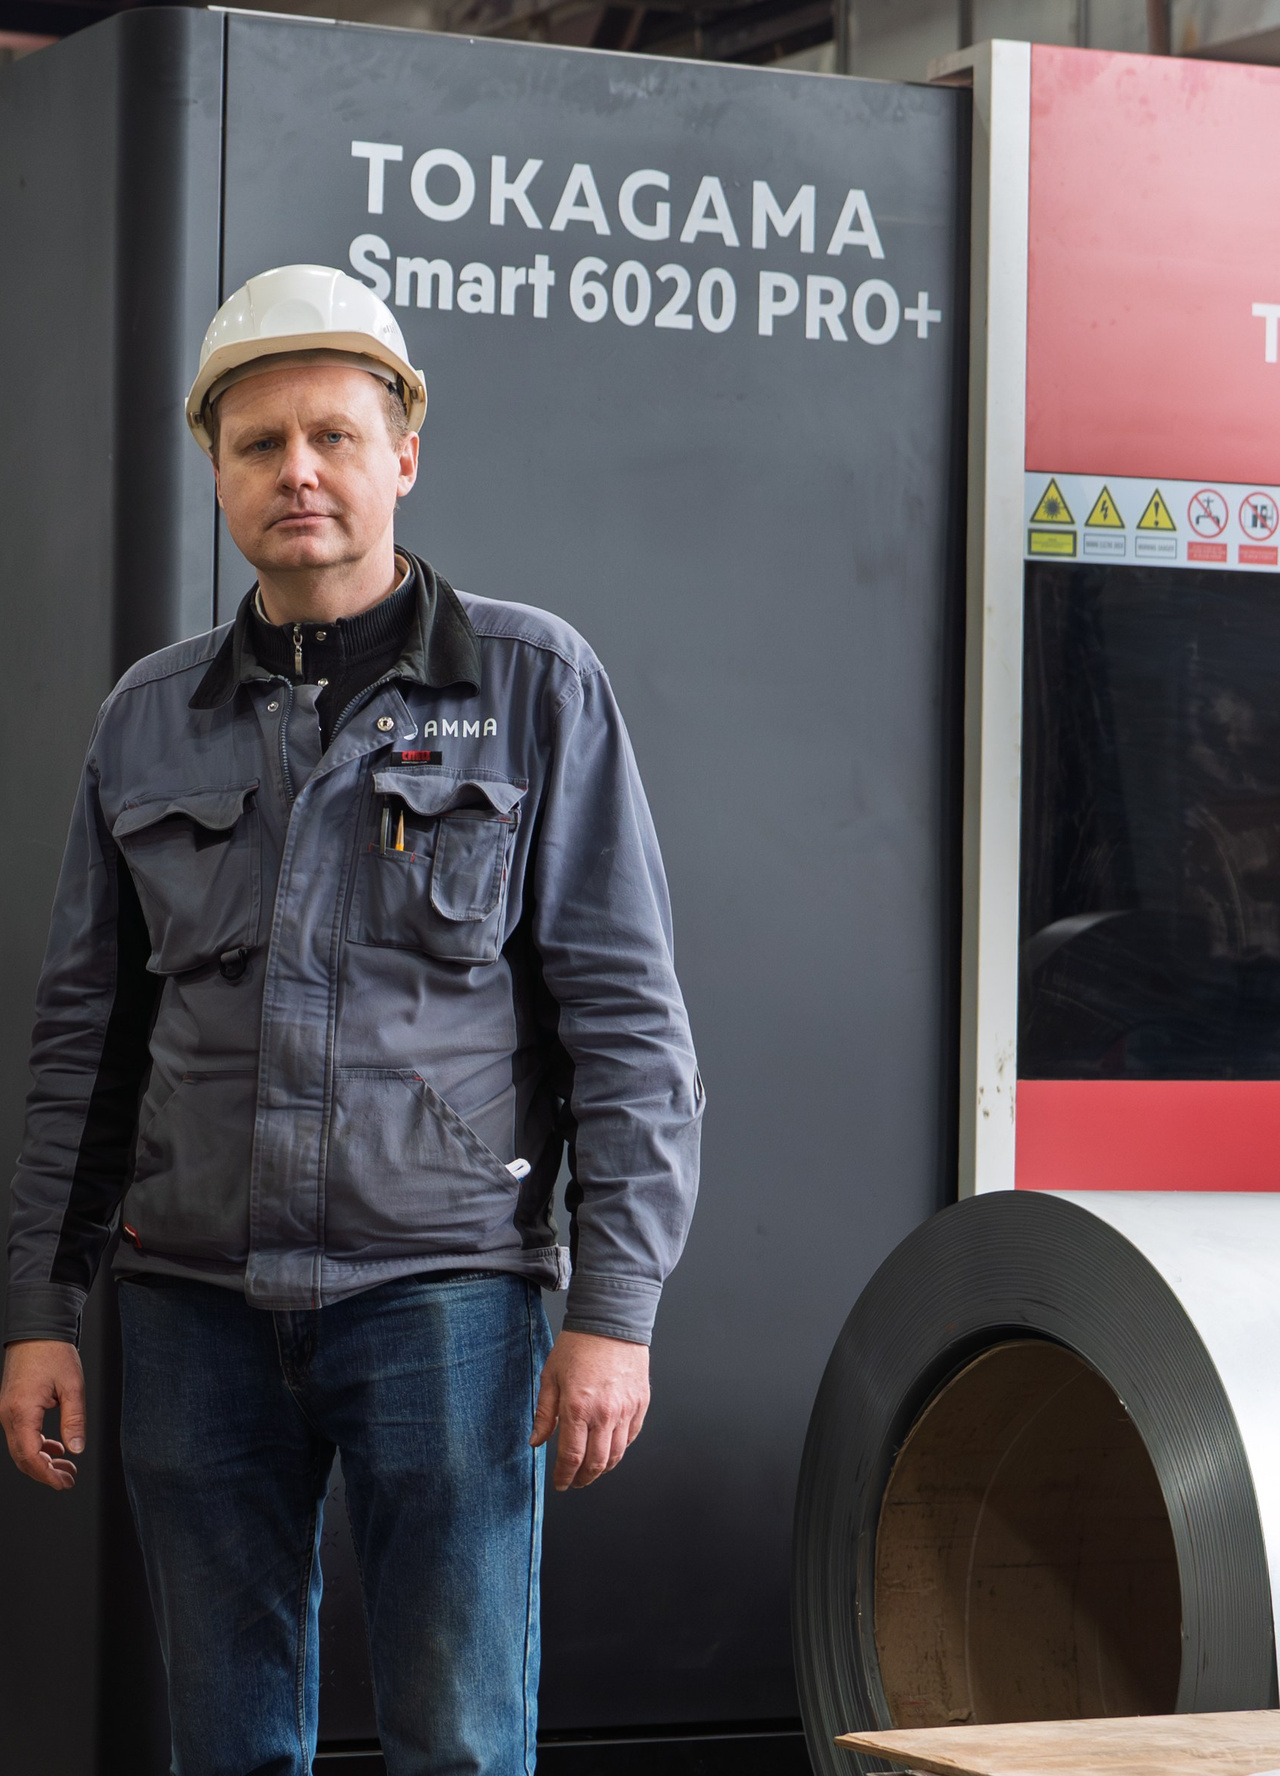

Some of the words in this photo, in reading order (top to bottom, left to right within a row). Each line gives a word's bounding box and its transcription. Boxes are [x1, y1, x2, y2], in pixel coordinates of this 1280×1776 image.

[349, 140, 886, 260] TOKAGAMA
[348, 233, 555, 319] Smart
[568, 255, 738, 333] 6020
[757, 269, 942, 346] PRO+
[424, 717, 498, 739] AMMA
